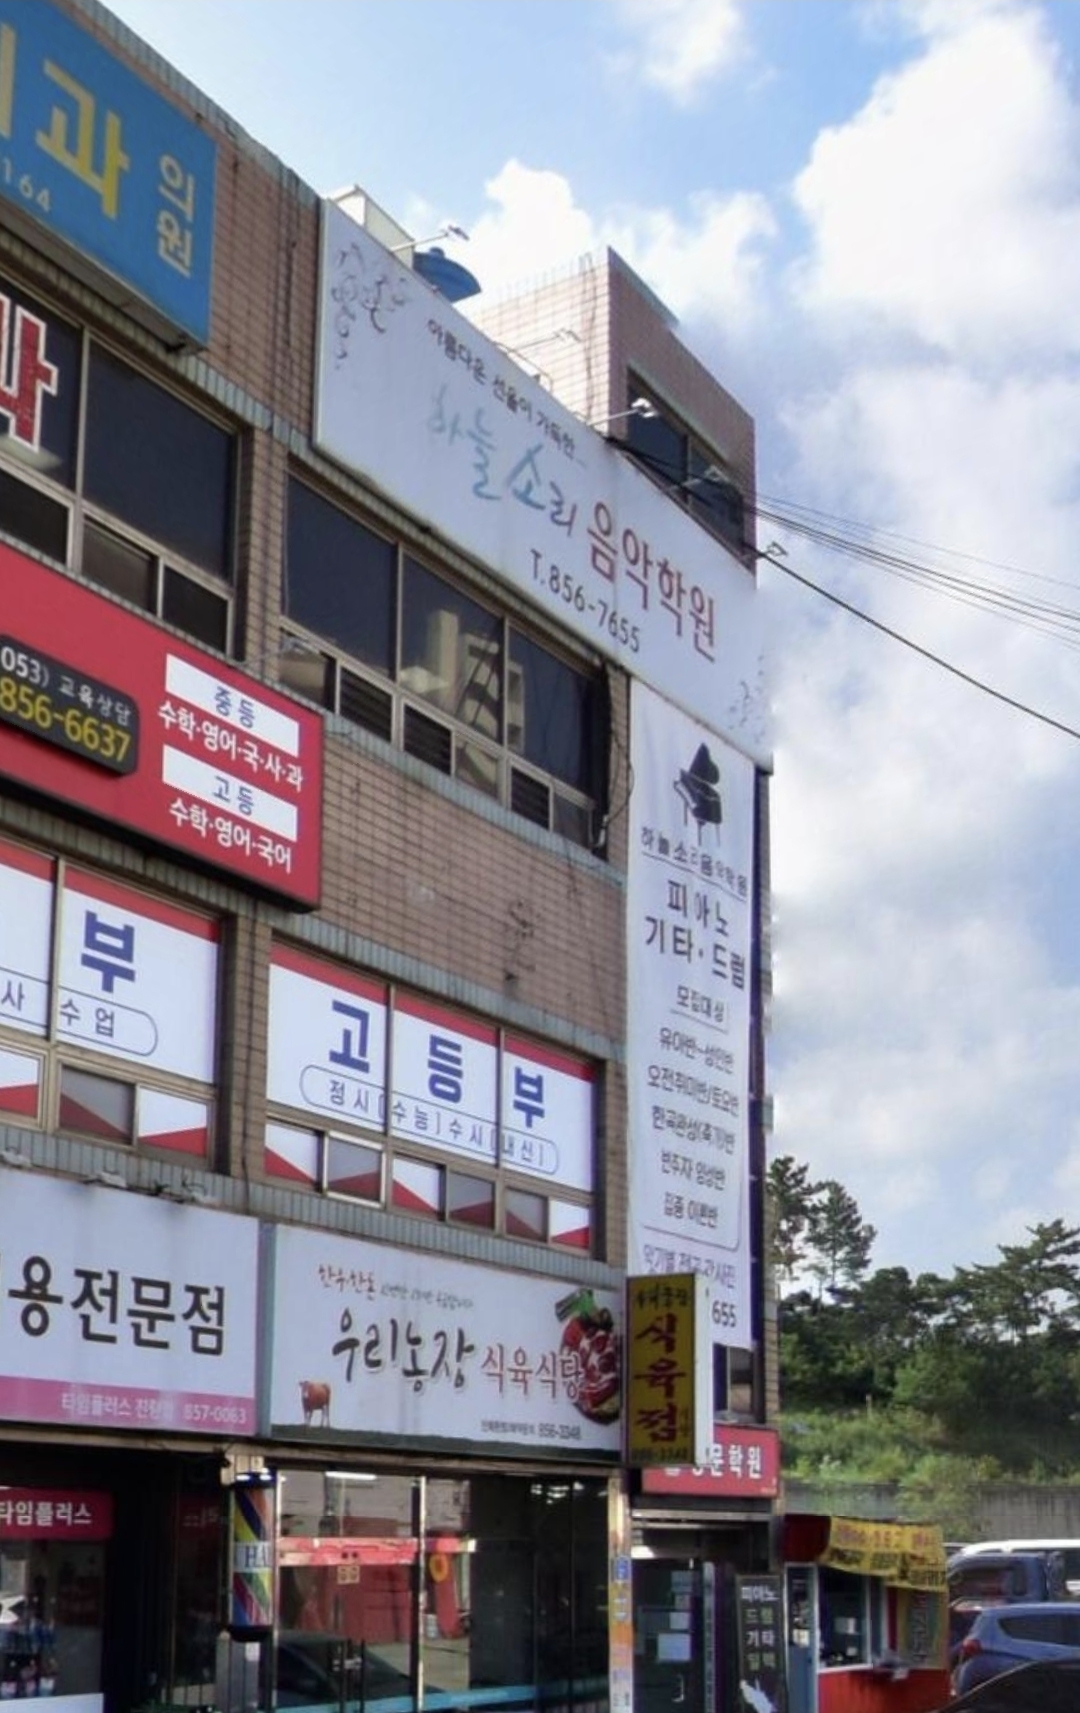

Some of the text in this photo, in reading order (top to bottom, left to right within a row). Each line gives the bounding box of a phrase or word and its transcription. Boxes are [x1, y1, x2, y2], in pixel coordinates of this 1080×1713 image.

[158, 154, 196, 279] 의원
[427, 319, 488, 386] 아름다운
[586, 501, 715, 664] 음악학원
[0, 676, 131, 763] 856-6637
[59, 674, 131, 727] 교육상담
[213, 685, 256, 729] 중등
[213, 775, 254, 816] 고등
[667, 879, 730, 938] 피아노
[80, 909, 136, 994] 부
[59, 998, 115, 1039] 수업
[676, 985, 725, 1024] 모집대상
[328, 1000, 546, 1129] 고등부
[7, 1254, 226, 1357] 용전문점
[332, 1306, 475, 1393] 우리농장
[634, 1312, 687, 1443] 식육점
